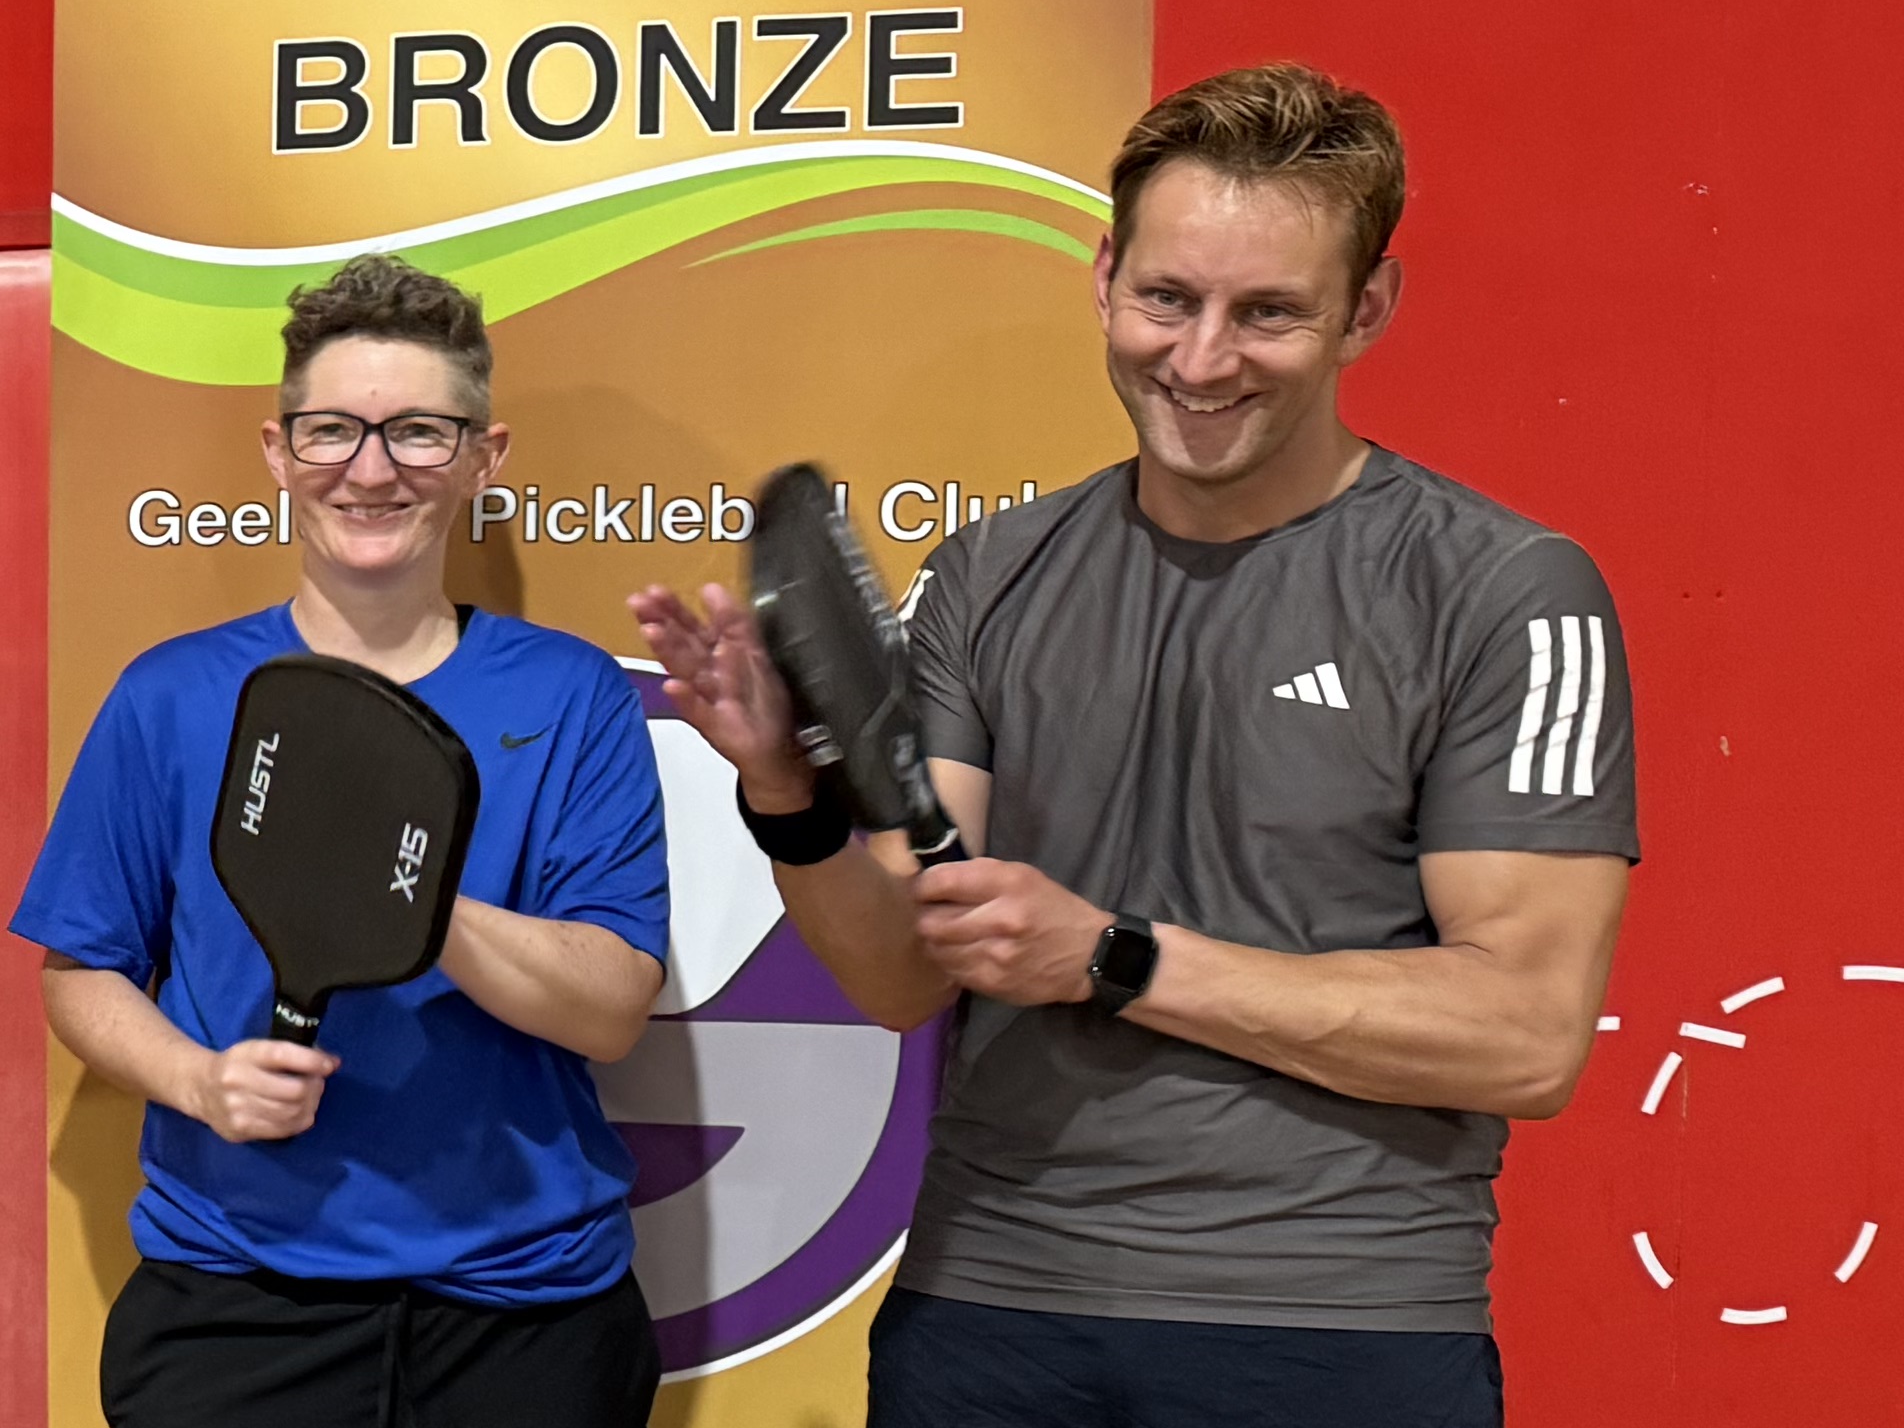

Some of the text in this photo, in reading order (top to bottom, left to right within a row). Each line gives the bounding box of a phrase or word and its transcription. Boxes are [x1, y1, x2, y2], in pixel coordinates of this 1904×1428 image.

[274, 10, 960, 150] BRONZE
[128, 487, 292, 547] Geel
[469, 482, 851, 545] Picklebl
[240, 732, 280, 835] HUSTL
[389, 822, 429, 904] X-15
